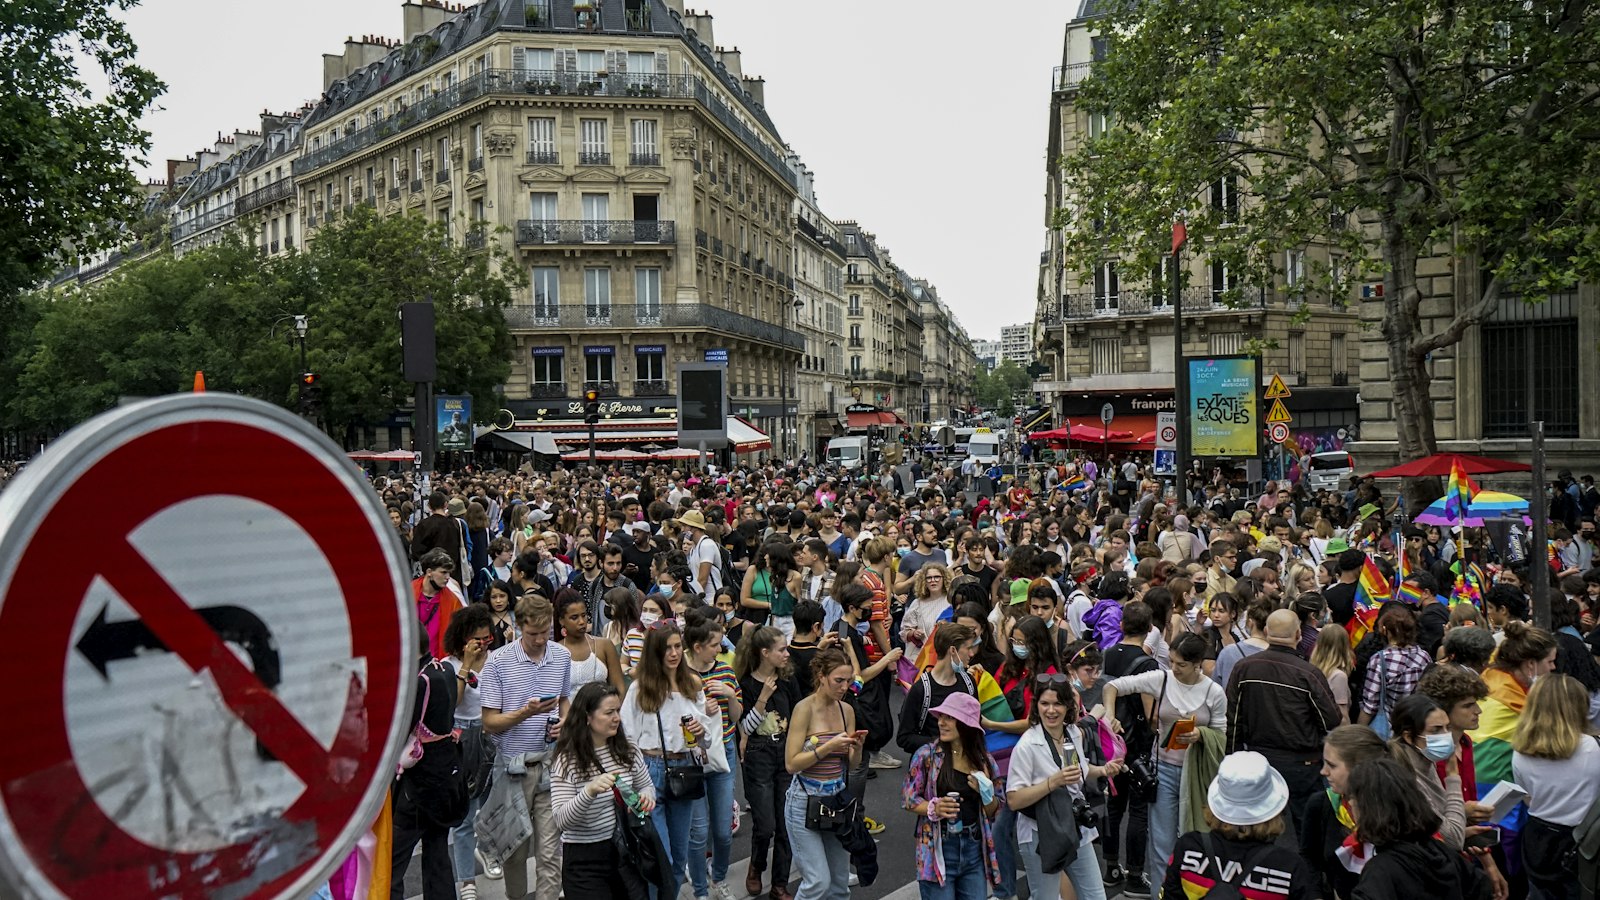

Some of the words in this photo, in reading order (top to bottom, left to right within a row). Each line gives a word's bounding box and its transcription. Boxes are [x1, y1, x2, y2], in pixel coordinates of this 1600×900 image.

[567, 401, 585, 413] Le
[609, 401, 643, 414] Pierre
[1164, 430, 1174, 438] 30
